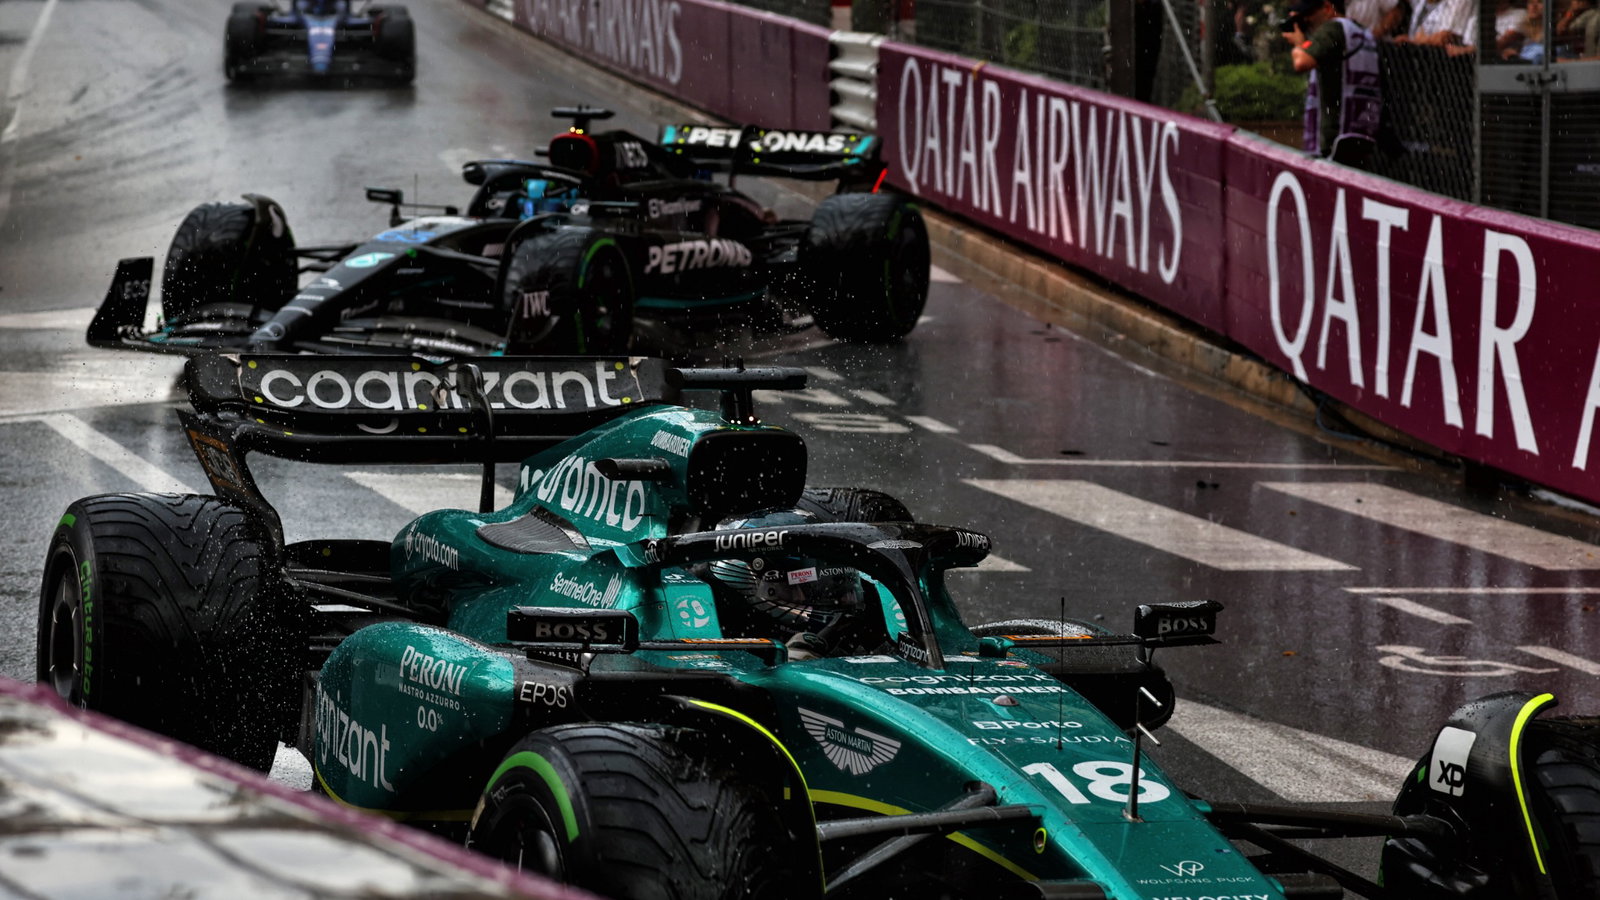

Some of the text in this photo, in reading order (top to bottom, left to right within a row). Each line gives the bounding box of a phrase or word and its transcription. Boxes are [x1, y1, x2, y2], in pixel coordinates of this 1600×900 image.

[687, 128, 846, 151] PETONAS
[900, 57, 1182, 284] QATAR AIRWAYS
[1266, 170, 1540, 455] QATAR
[414, 531, 459, 571] crypto.com
[790, 570, 813, 578] PERONI
[819, 568, 843, 576] ASTON
[550, 572, 602, 607] SentinelOne
[535, 621, 608, 640] BOSS
[1158, 617, 1208, 634] BOSS
[399, 645, 467, 696] PERONI
[859, 674, 1056, 685] cognizant
[398, 682, 460, 711] NASTRO AZZURRO
[519, 681, 567, 708] EPOS
[886, 686, 1068, 695] BOMBARDIER
[417, 705, 444, 732] 0.0%
[826, 728, 872, 753] ASTON MARTIN
[1030, 736, 1132, 744] SAUDIA
[1021, 760, 1171, 804] 18
